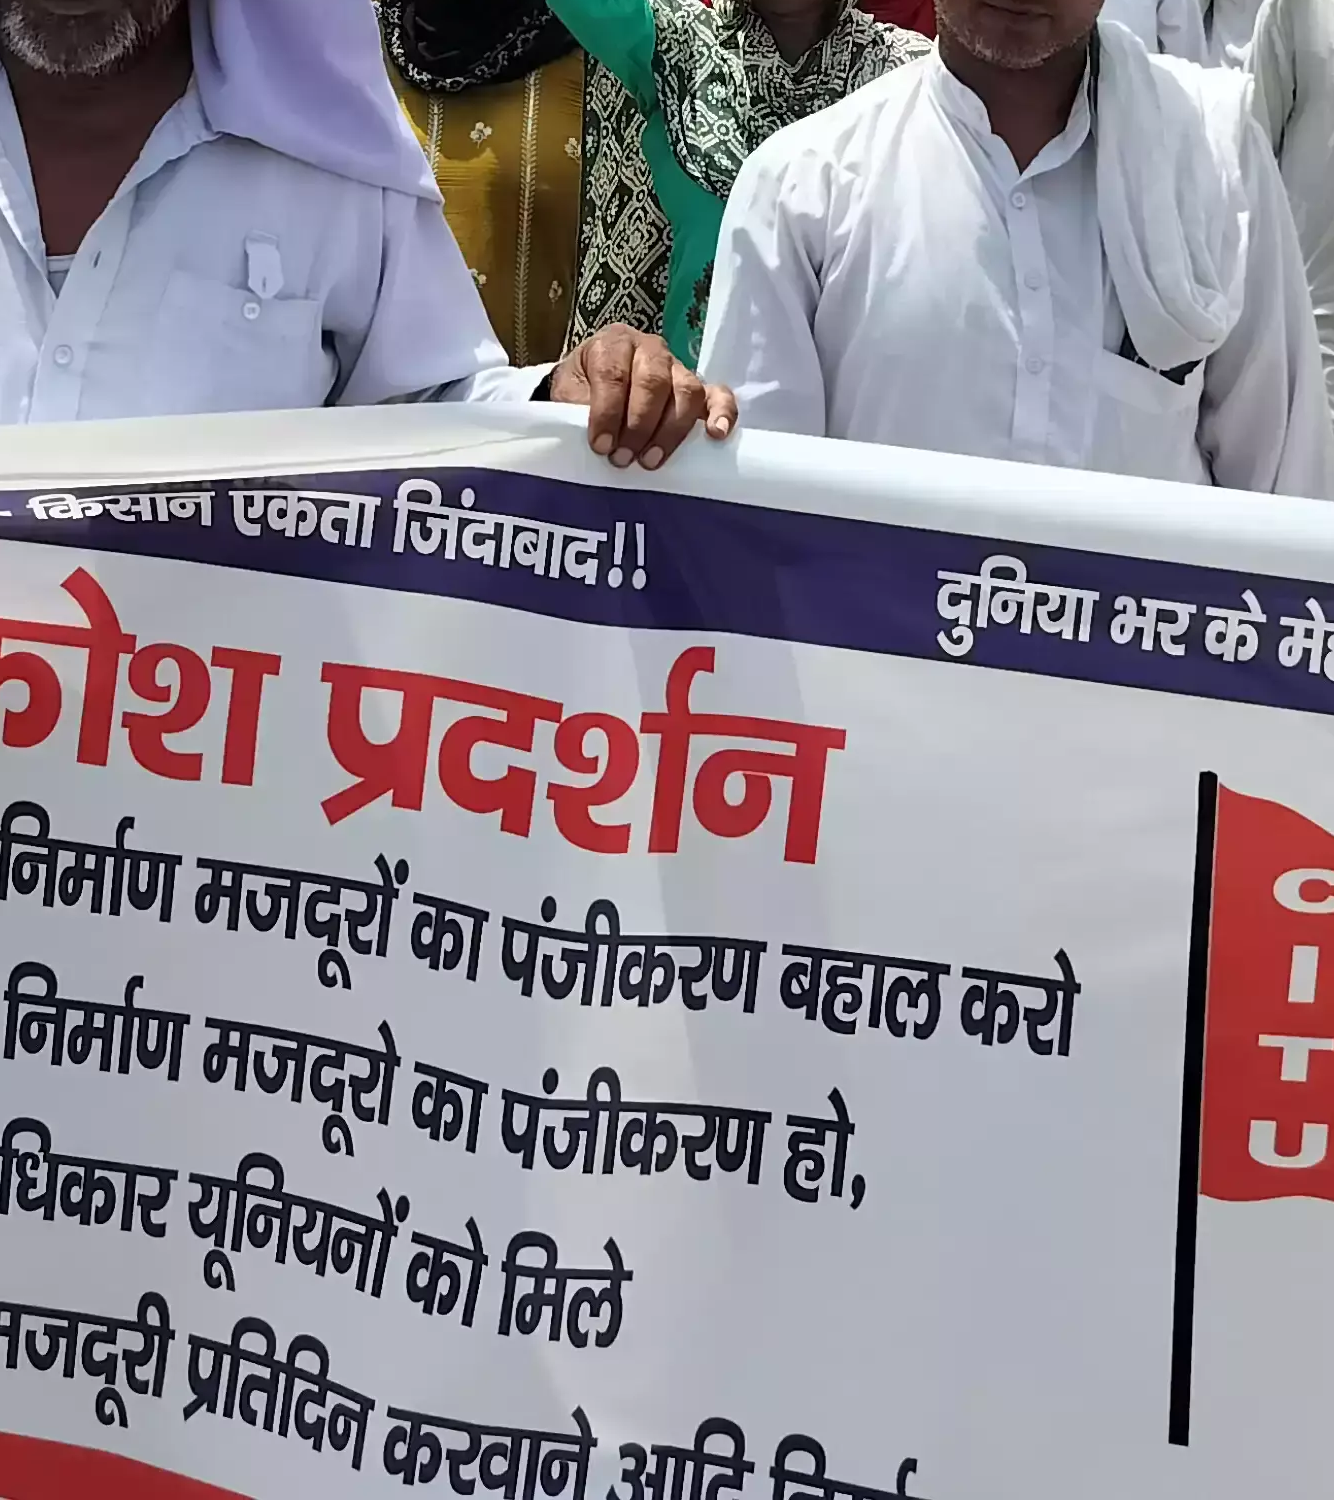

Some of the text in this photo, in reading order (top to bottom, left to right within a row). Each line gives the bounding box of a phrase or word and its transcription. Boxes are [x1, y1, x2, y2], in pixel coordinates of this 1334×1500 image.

[228, 489, 381, 549] एकता
[393, 478, 647, 590] जिंदाबाद!!
[936, 555, 1099, 657] दुनिया
[1109, 593, 1197, 657] भर
[1205, 591, 1267, 663] के
[320, 646, 847, 865] प्रदर्शन
[195, 853, 409, 991] मजदूरों
[411, 892, 489, 981] का
[500, 895, 767, 1015] पंजीकरण
[779, 944, 950, 1040] बहाल
[961, 948, 1081, 1057] करो
[2, 961, 191, 1083] निर्माण
[203, 1016, 400, 1157] मजदूरो
[411, 1061, 488, 1155] का
[500, 1066, 771, 1187] पंजीकरण
[783, 1087, 866, 1211] हो,
[189, 1151, 410, 1298] यूनियनों
[406, 1217, 488, 1330] को
[498, 1230, 633, 1349] मिले
[183, 1316, 375, 1473] प्रतिदिन
[383, 1405, 597, 1500] करवाने
